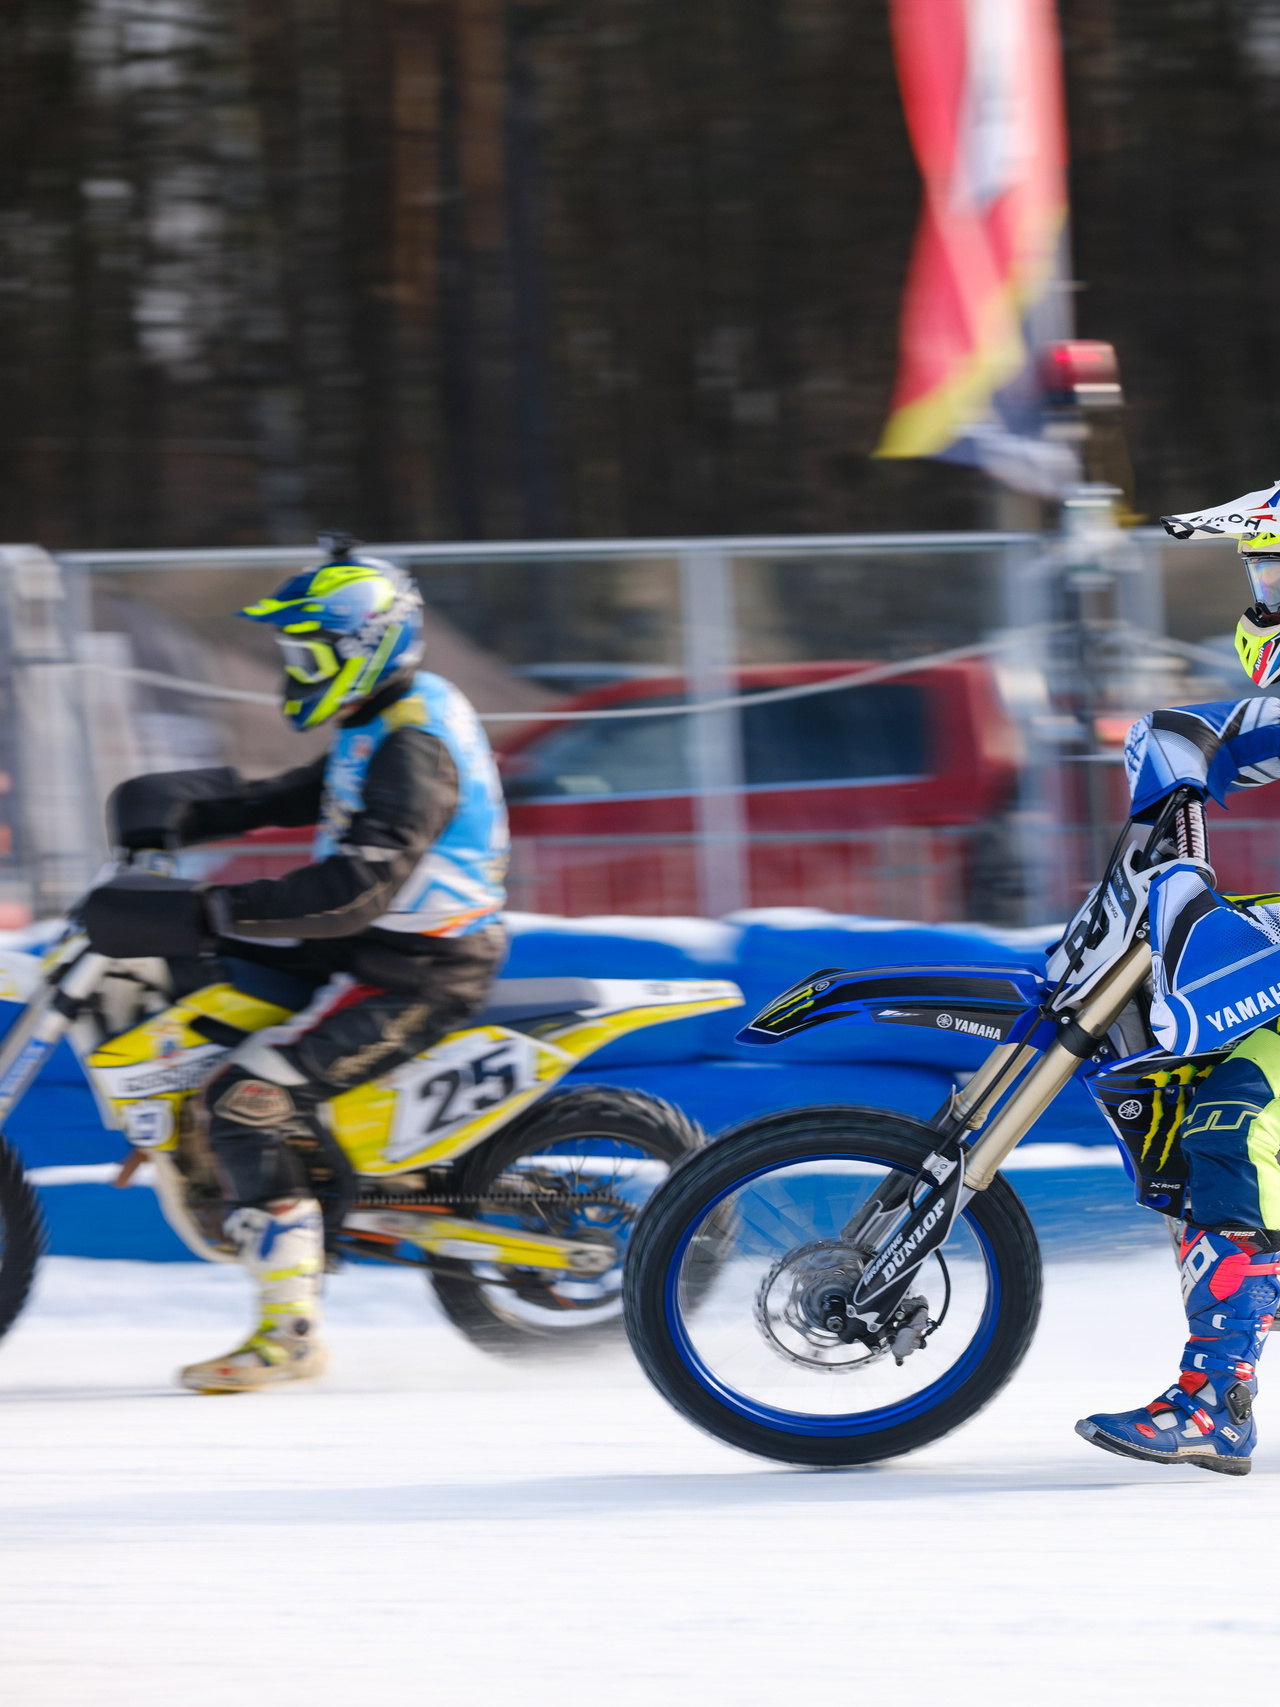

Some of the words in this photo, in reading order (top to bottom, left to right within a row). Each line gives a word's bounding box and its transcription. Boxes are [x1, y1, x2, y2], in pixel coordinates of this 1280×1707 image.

[1254, 647, 1265, 671] Airoh
[1188, 802, 1206, 860] RENTHA
[954, 1018, 1002, 1040] YAMAHA
[419, 1045, 516, 1133] 25
[863, 1232, 904, 1286] BRAKING
[881, 1197, 946, 1283] DUNLOP
